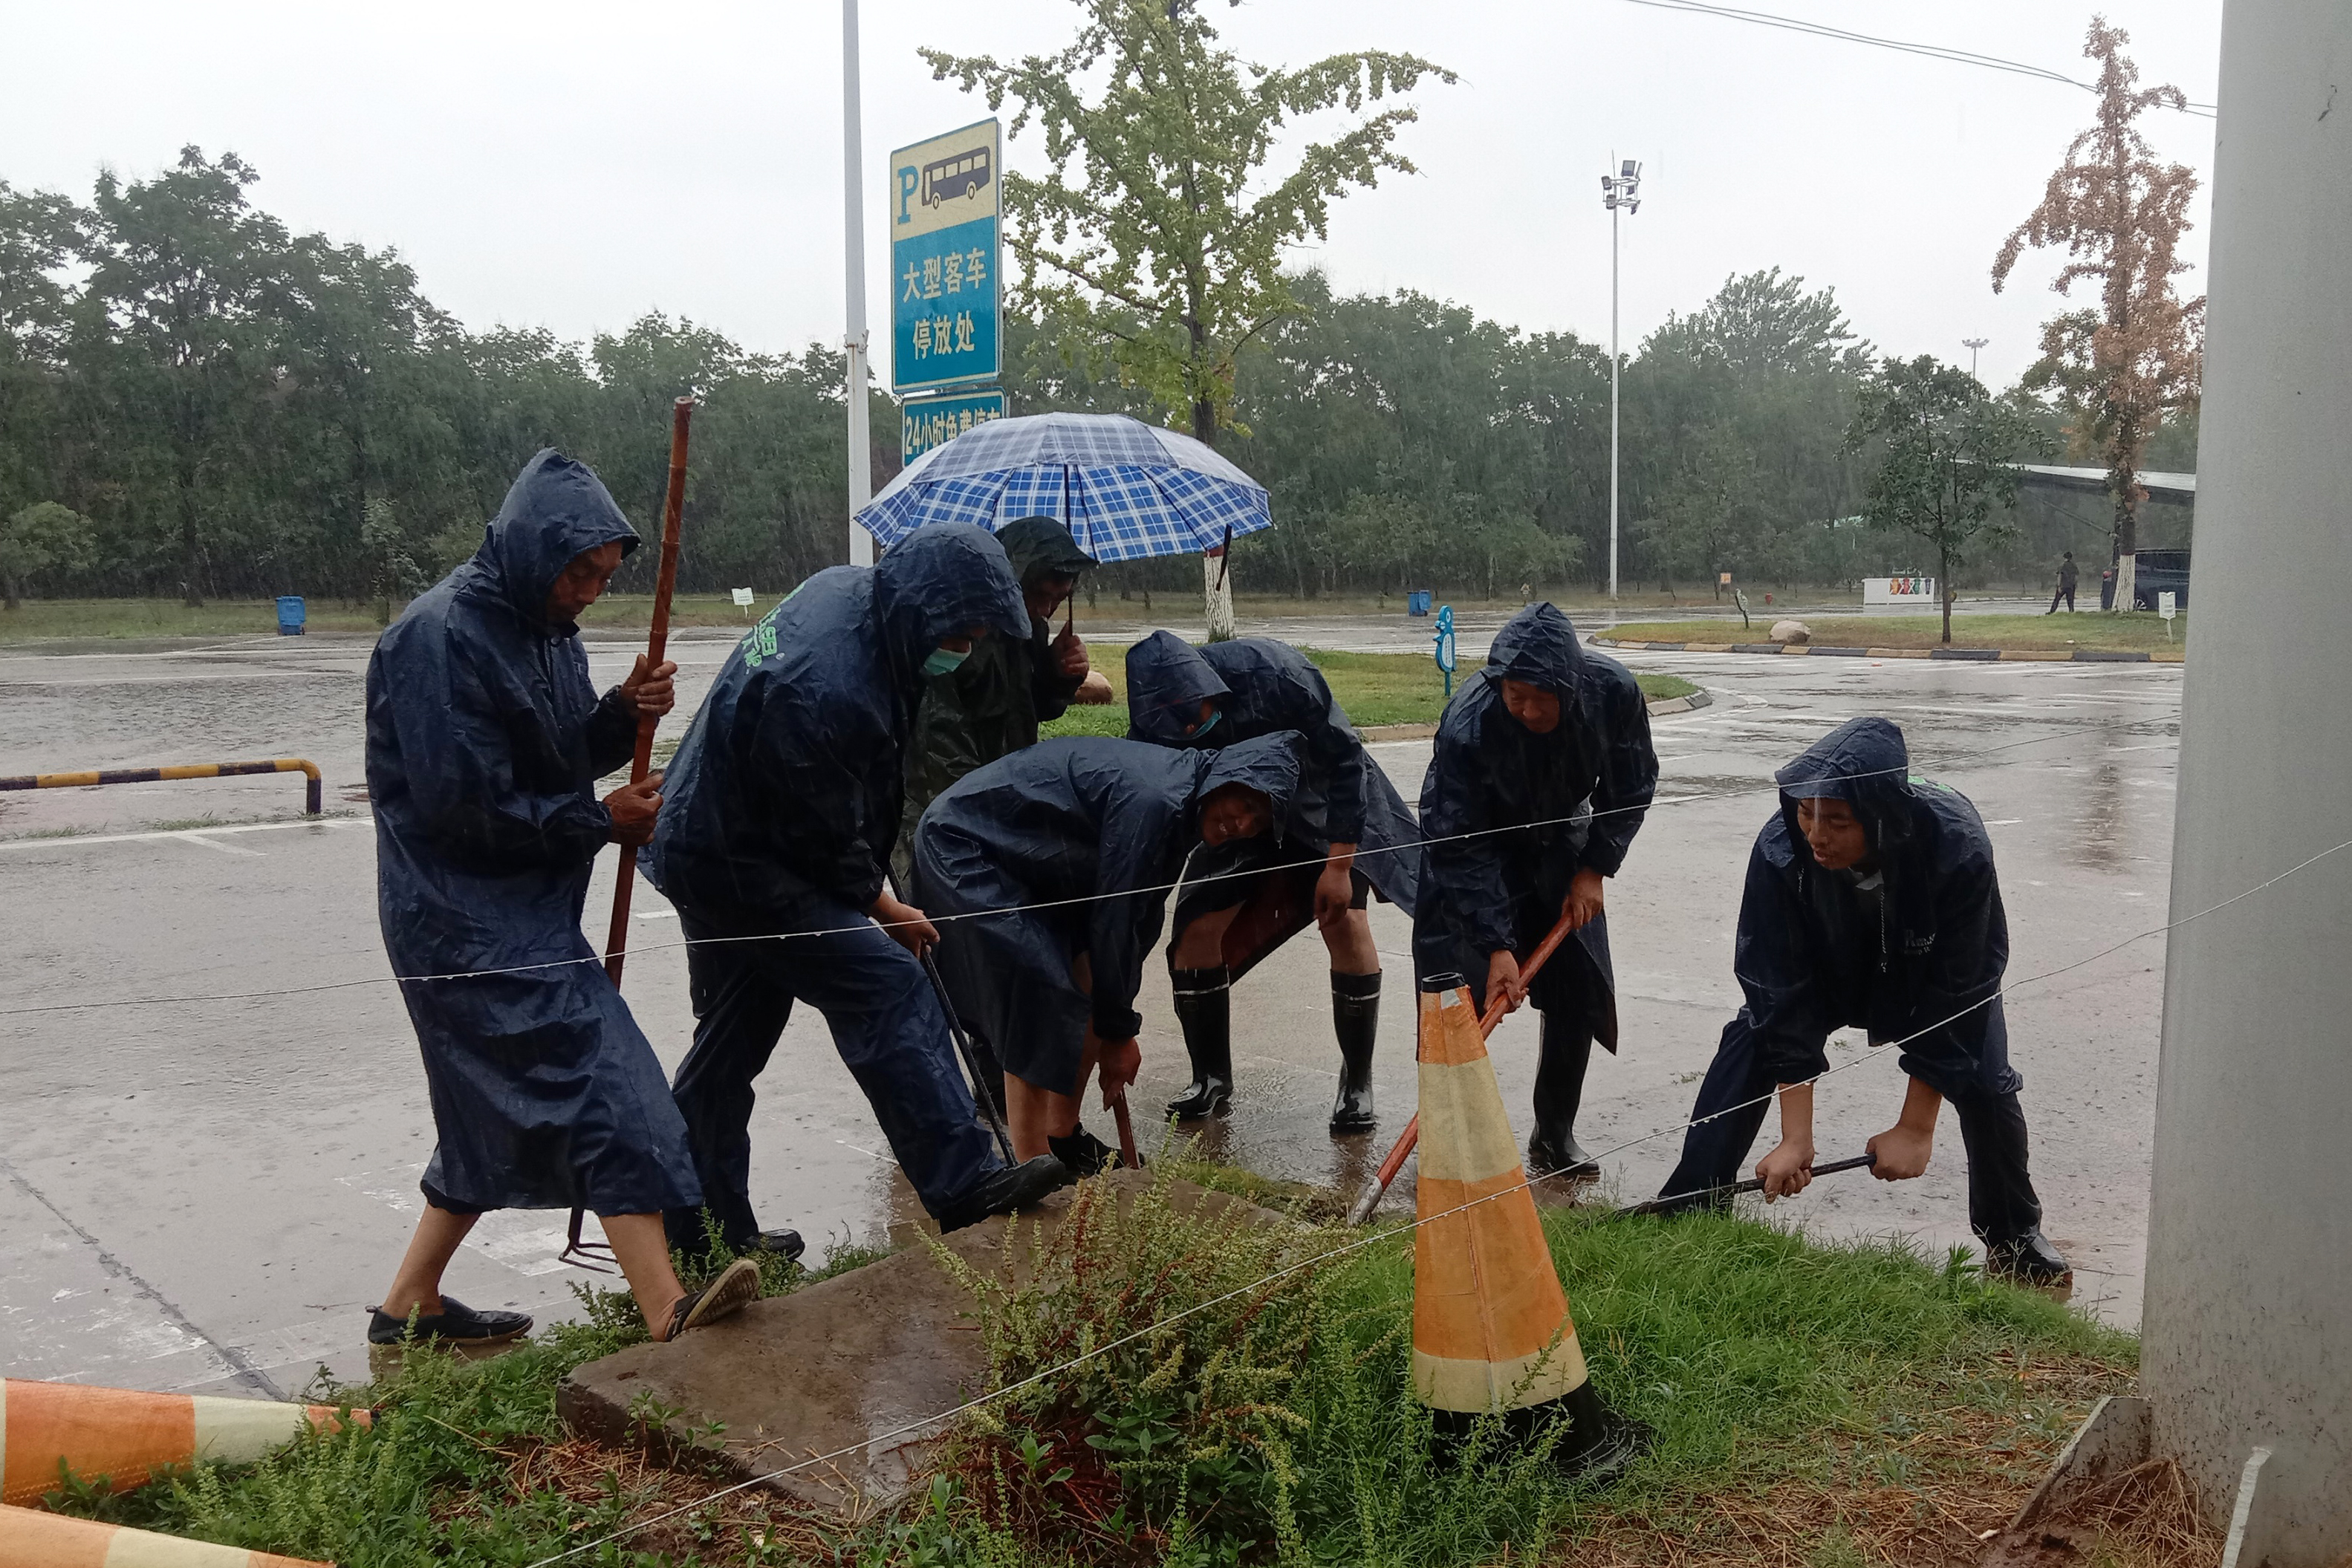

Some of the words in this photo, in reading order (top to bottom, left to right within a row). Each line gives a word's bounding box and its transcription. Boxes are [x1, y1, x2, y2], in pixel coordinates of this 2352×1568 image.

[897, 165, 919, 225] P
[903, 247, 987, 304] 大型客车
[912, 310, 975, 360] 停放处
